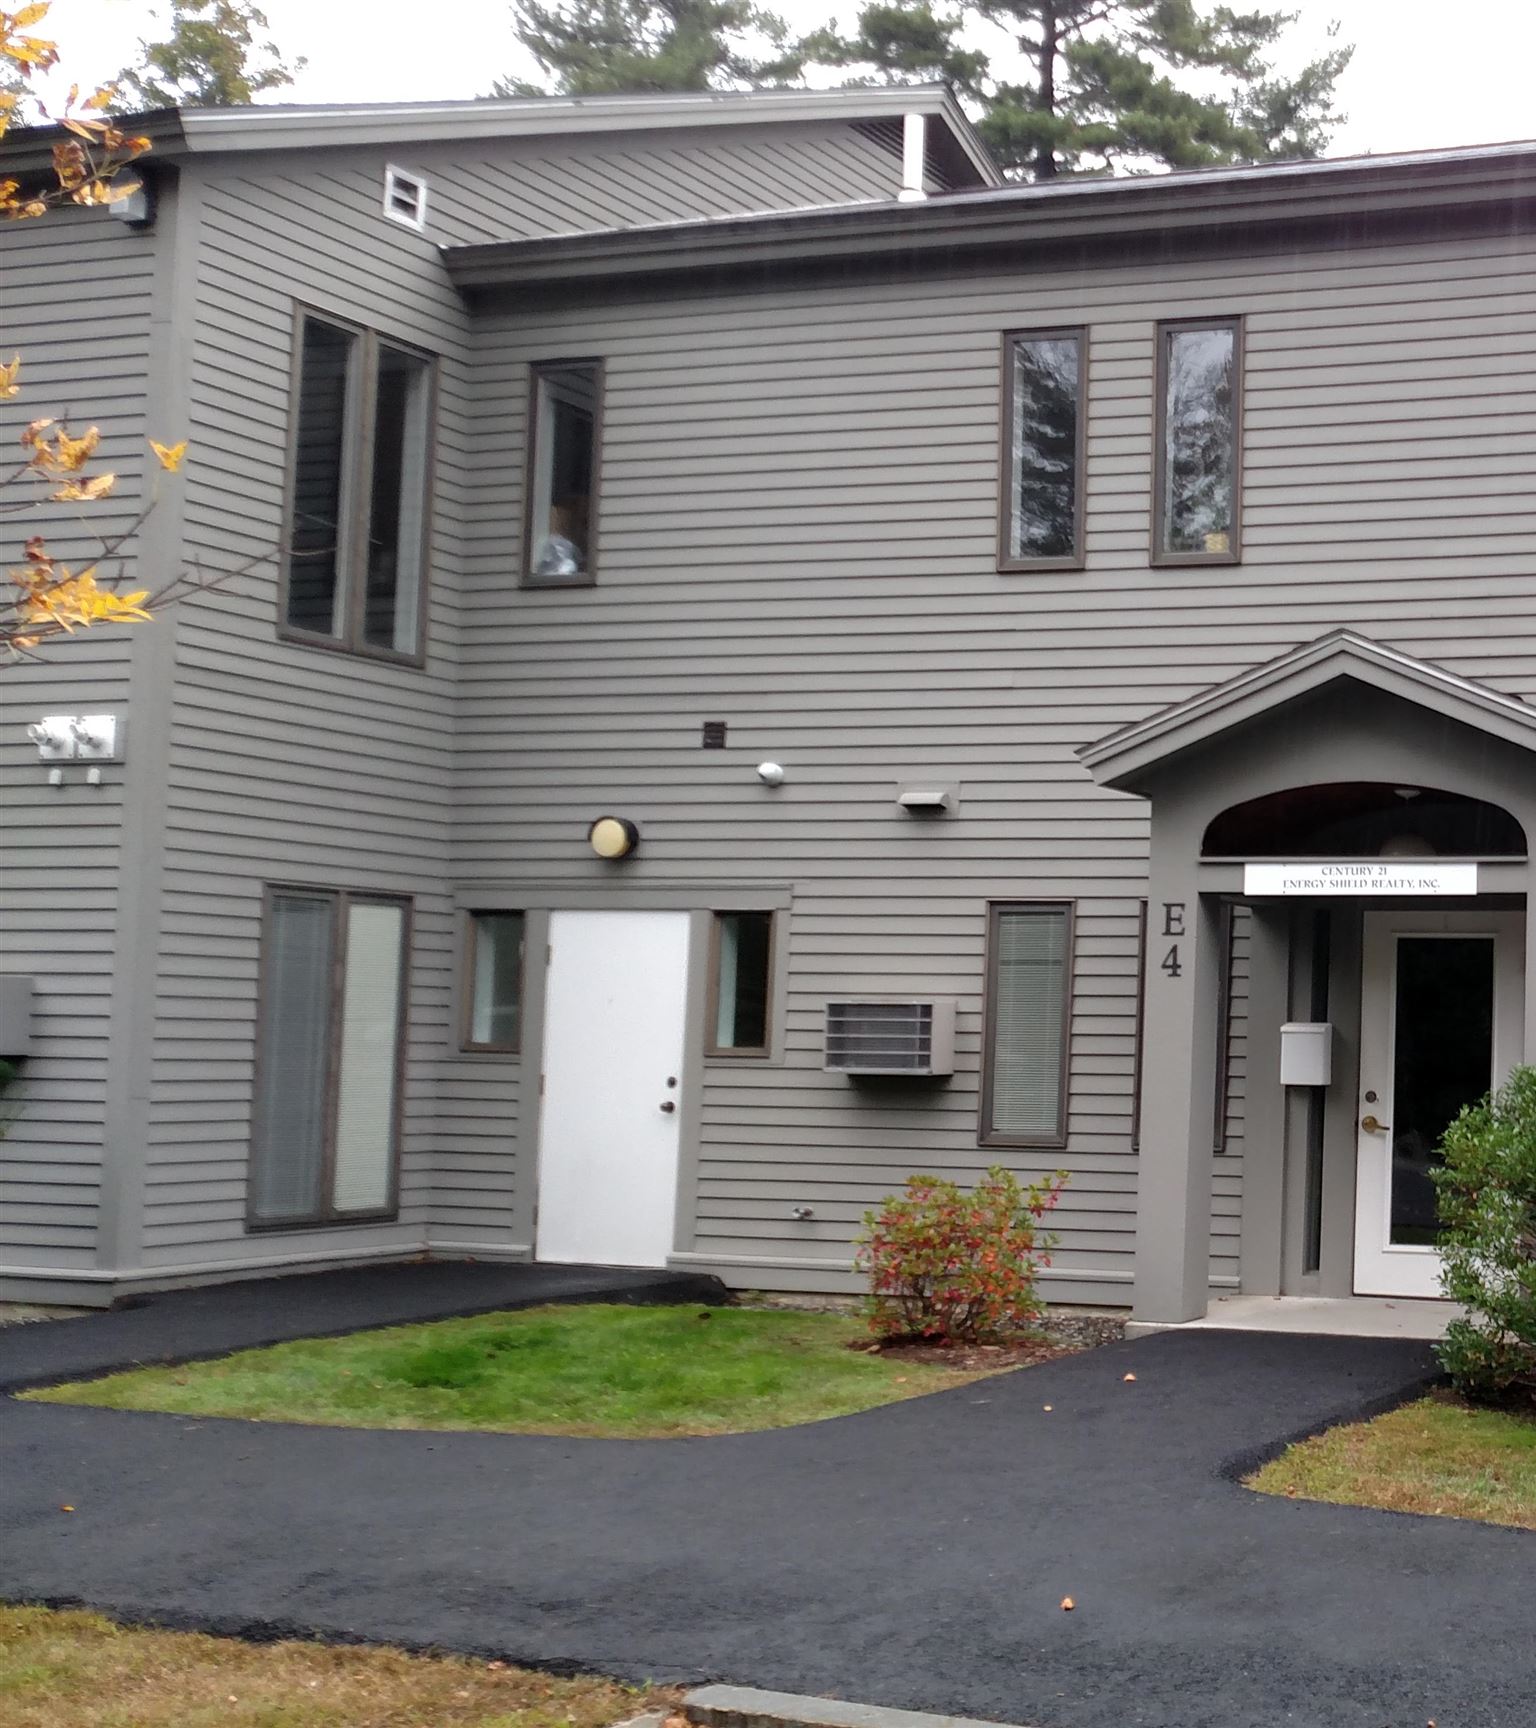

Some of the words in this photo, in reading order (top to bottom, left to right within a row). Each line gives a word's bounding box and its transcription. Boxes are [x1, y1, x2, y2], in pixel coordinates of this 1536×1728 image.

[1321, 866, 1374, 876] CENTURY
[1378, 866, 1387, 876] 21
[1283, 879, 1326, 889] ENERGY
[1329, 879, 1368, 889] SHIELD
[1371, 879, 1415, 889] REALTY,
[1418, 879, 1440, 889] INC.
[1161, 903, 1186, 936] E
[1161, 944, 1182, 977] 4
